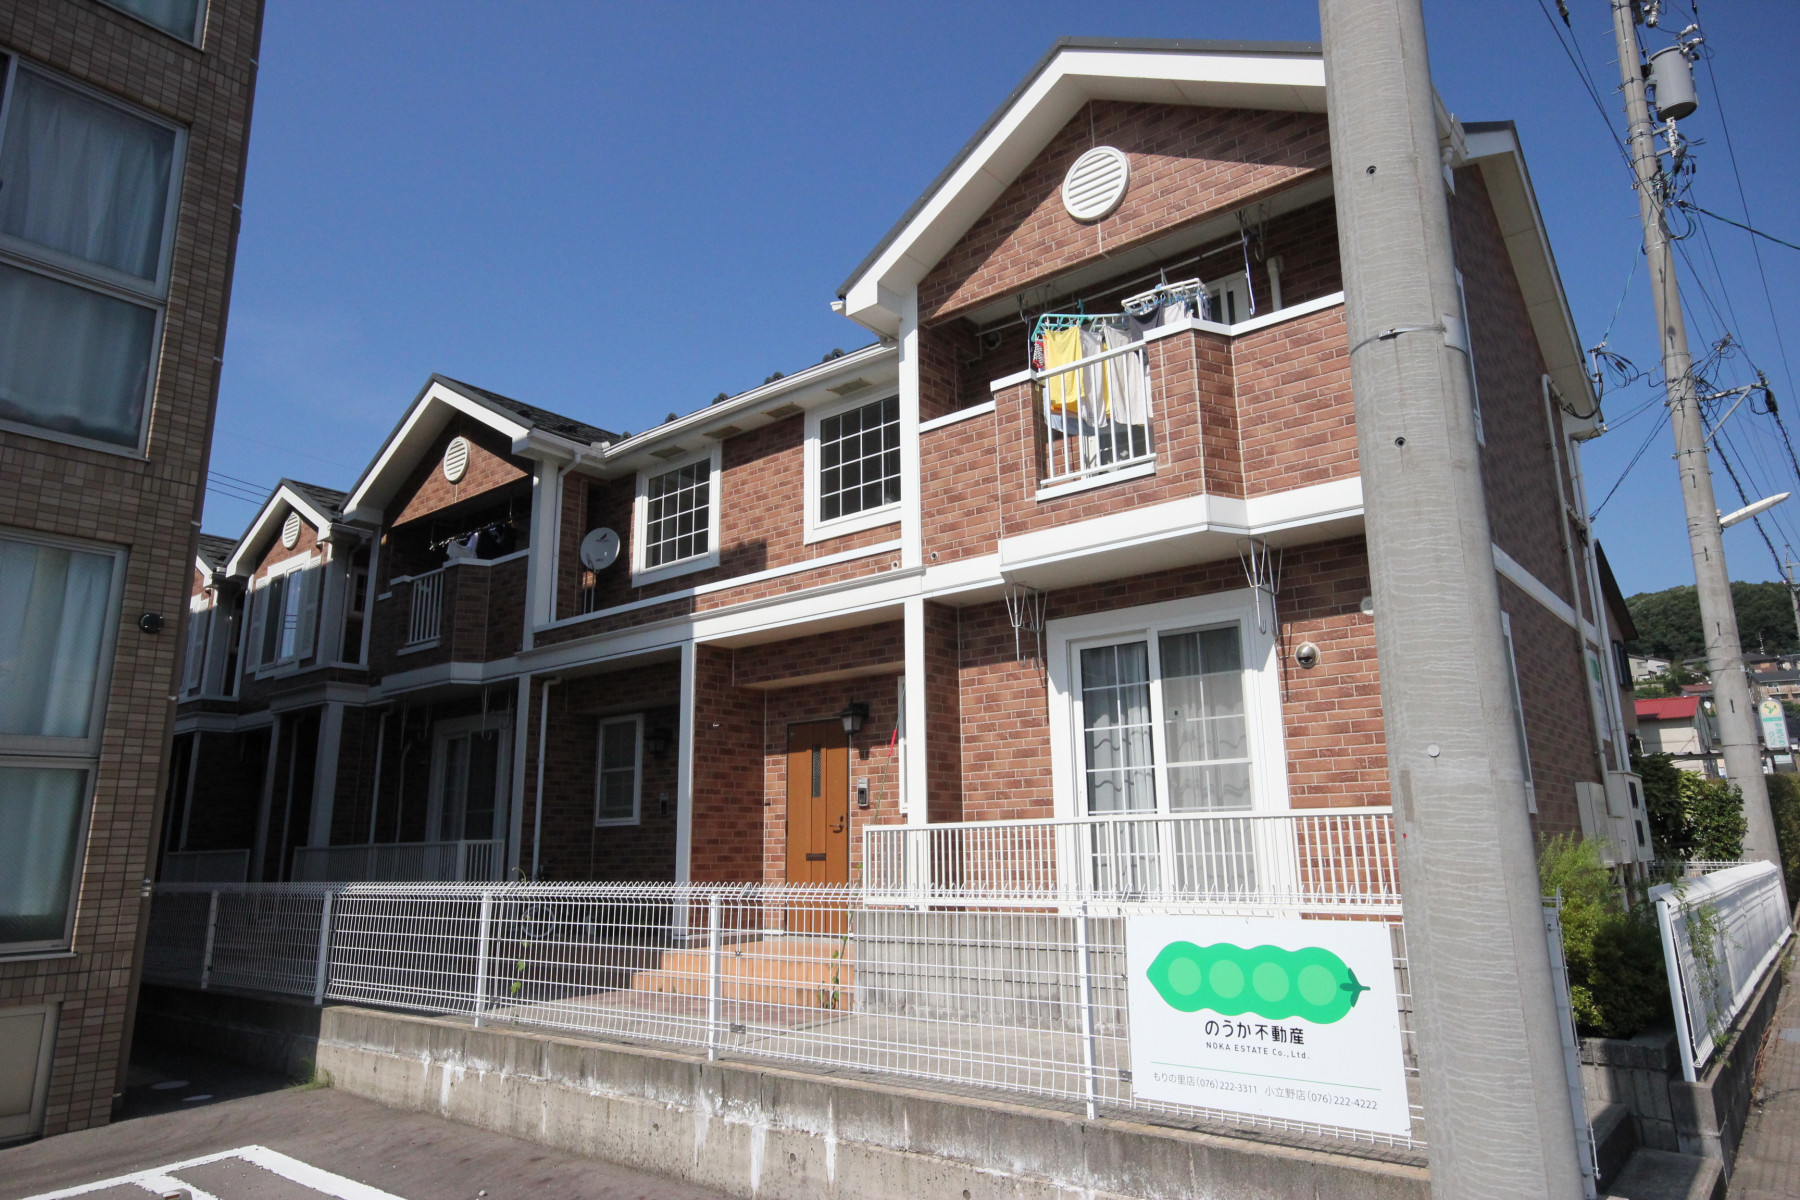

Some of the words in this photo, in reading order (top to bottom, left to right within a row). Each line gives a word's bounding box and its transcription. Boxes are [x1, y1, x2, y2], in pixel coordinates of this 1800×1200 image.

[1204, 1019, 1305, 1045] のうか不動産
[1206, 1041, 1231, 1051] NOKA
[1234, 1044, 1269, 1055] ESTATE
